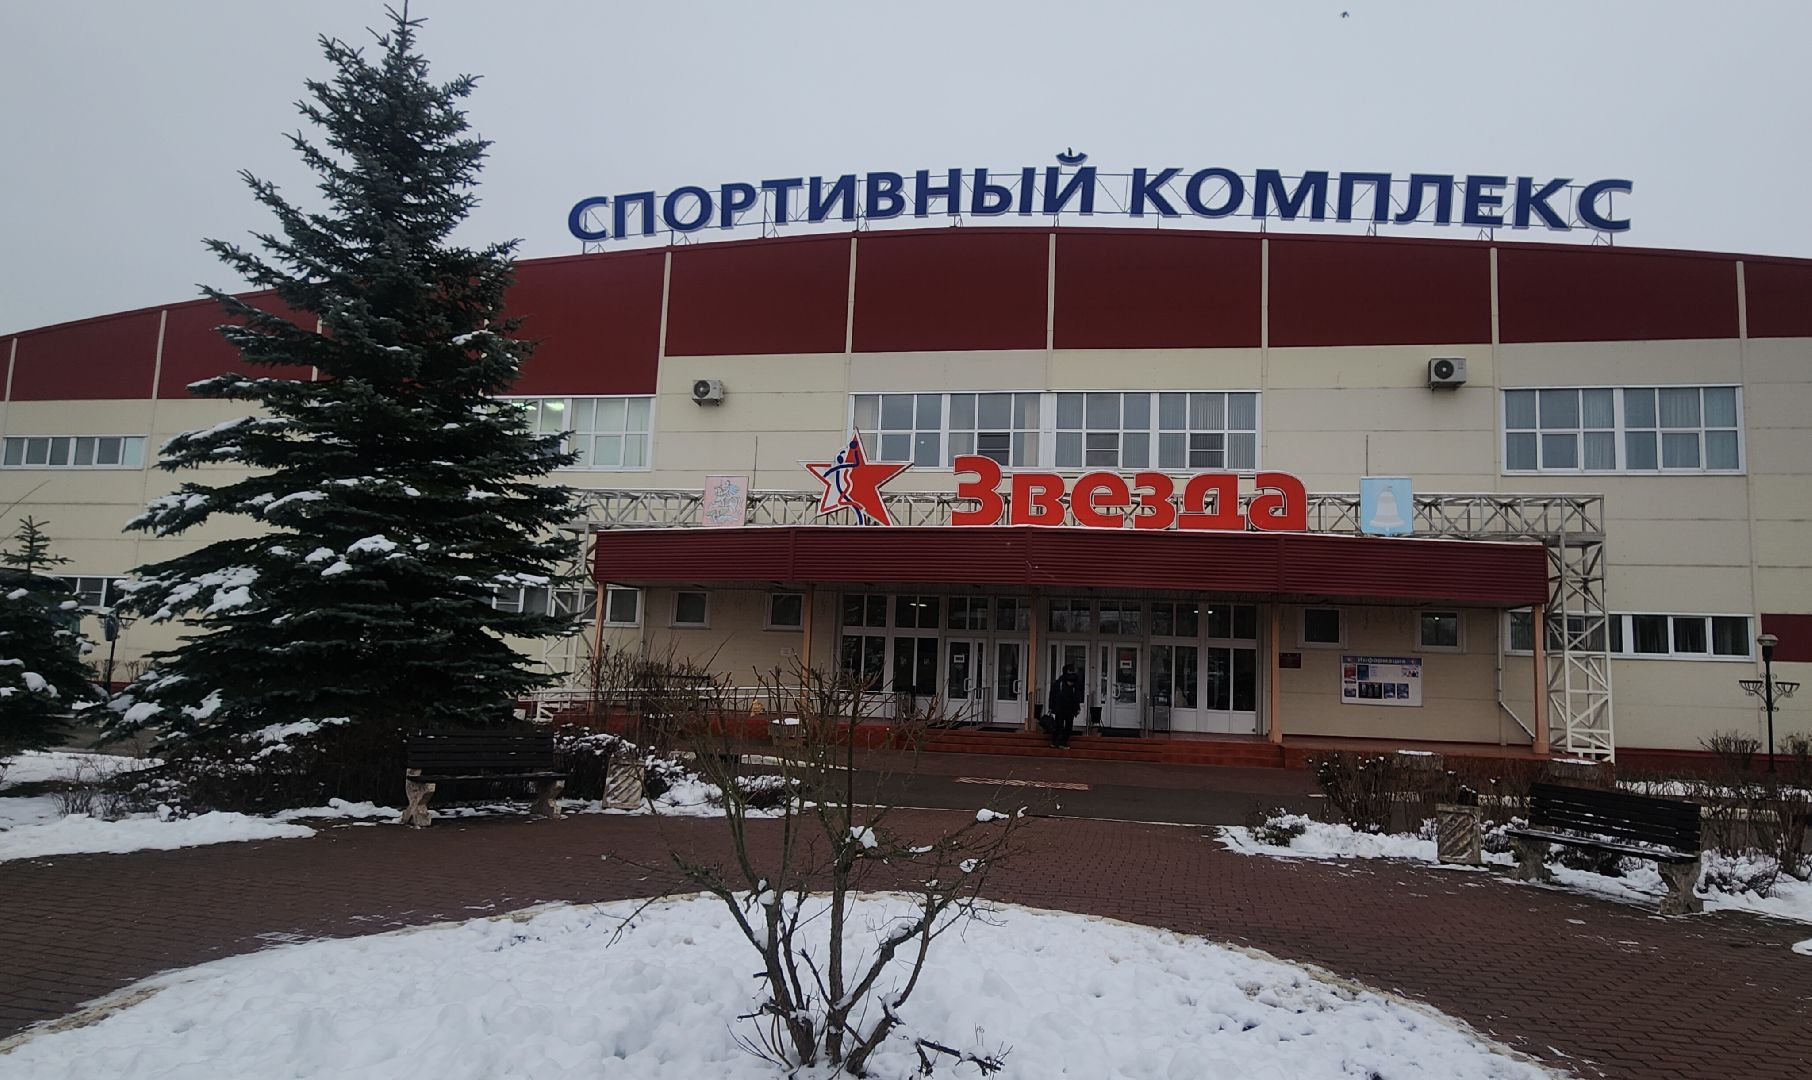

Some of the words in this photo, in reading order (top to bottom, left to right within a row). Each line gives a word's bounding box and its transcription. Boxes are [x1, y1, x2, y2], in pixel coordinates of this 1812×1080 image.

[568, 152, 1097, 241] СПОРТИВНЫЙ
[1130, 167, 1633, 232] КОМПЛЕКС
[951, 453, 1308, 532] Звезда
